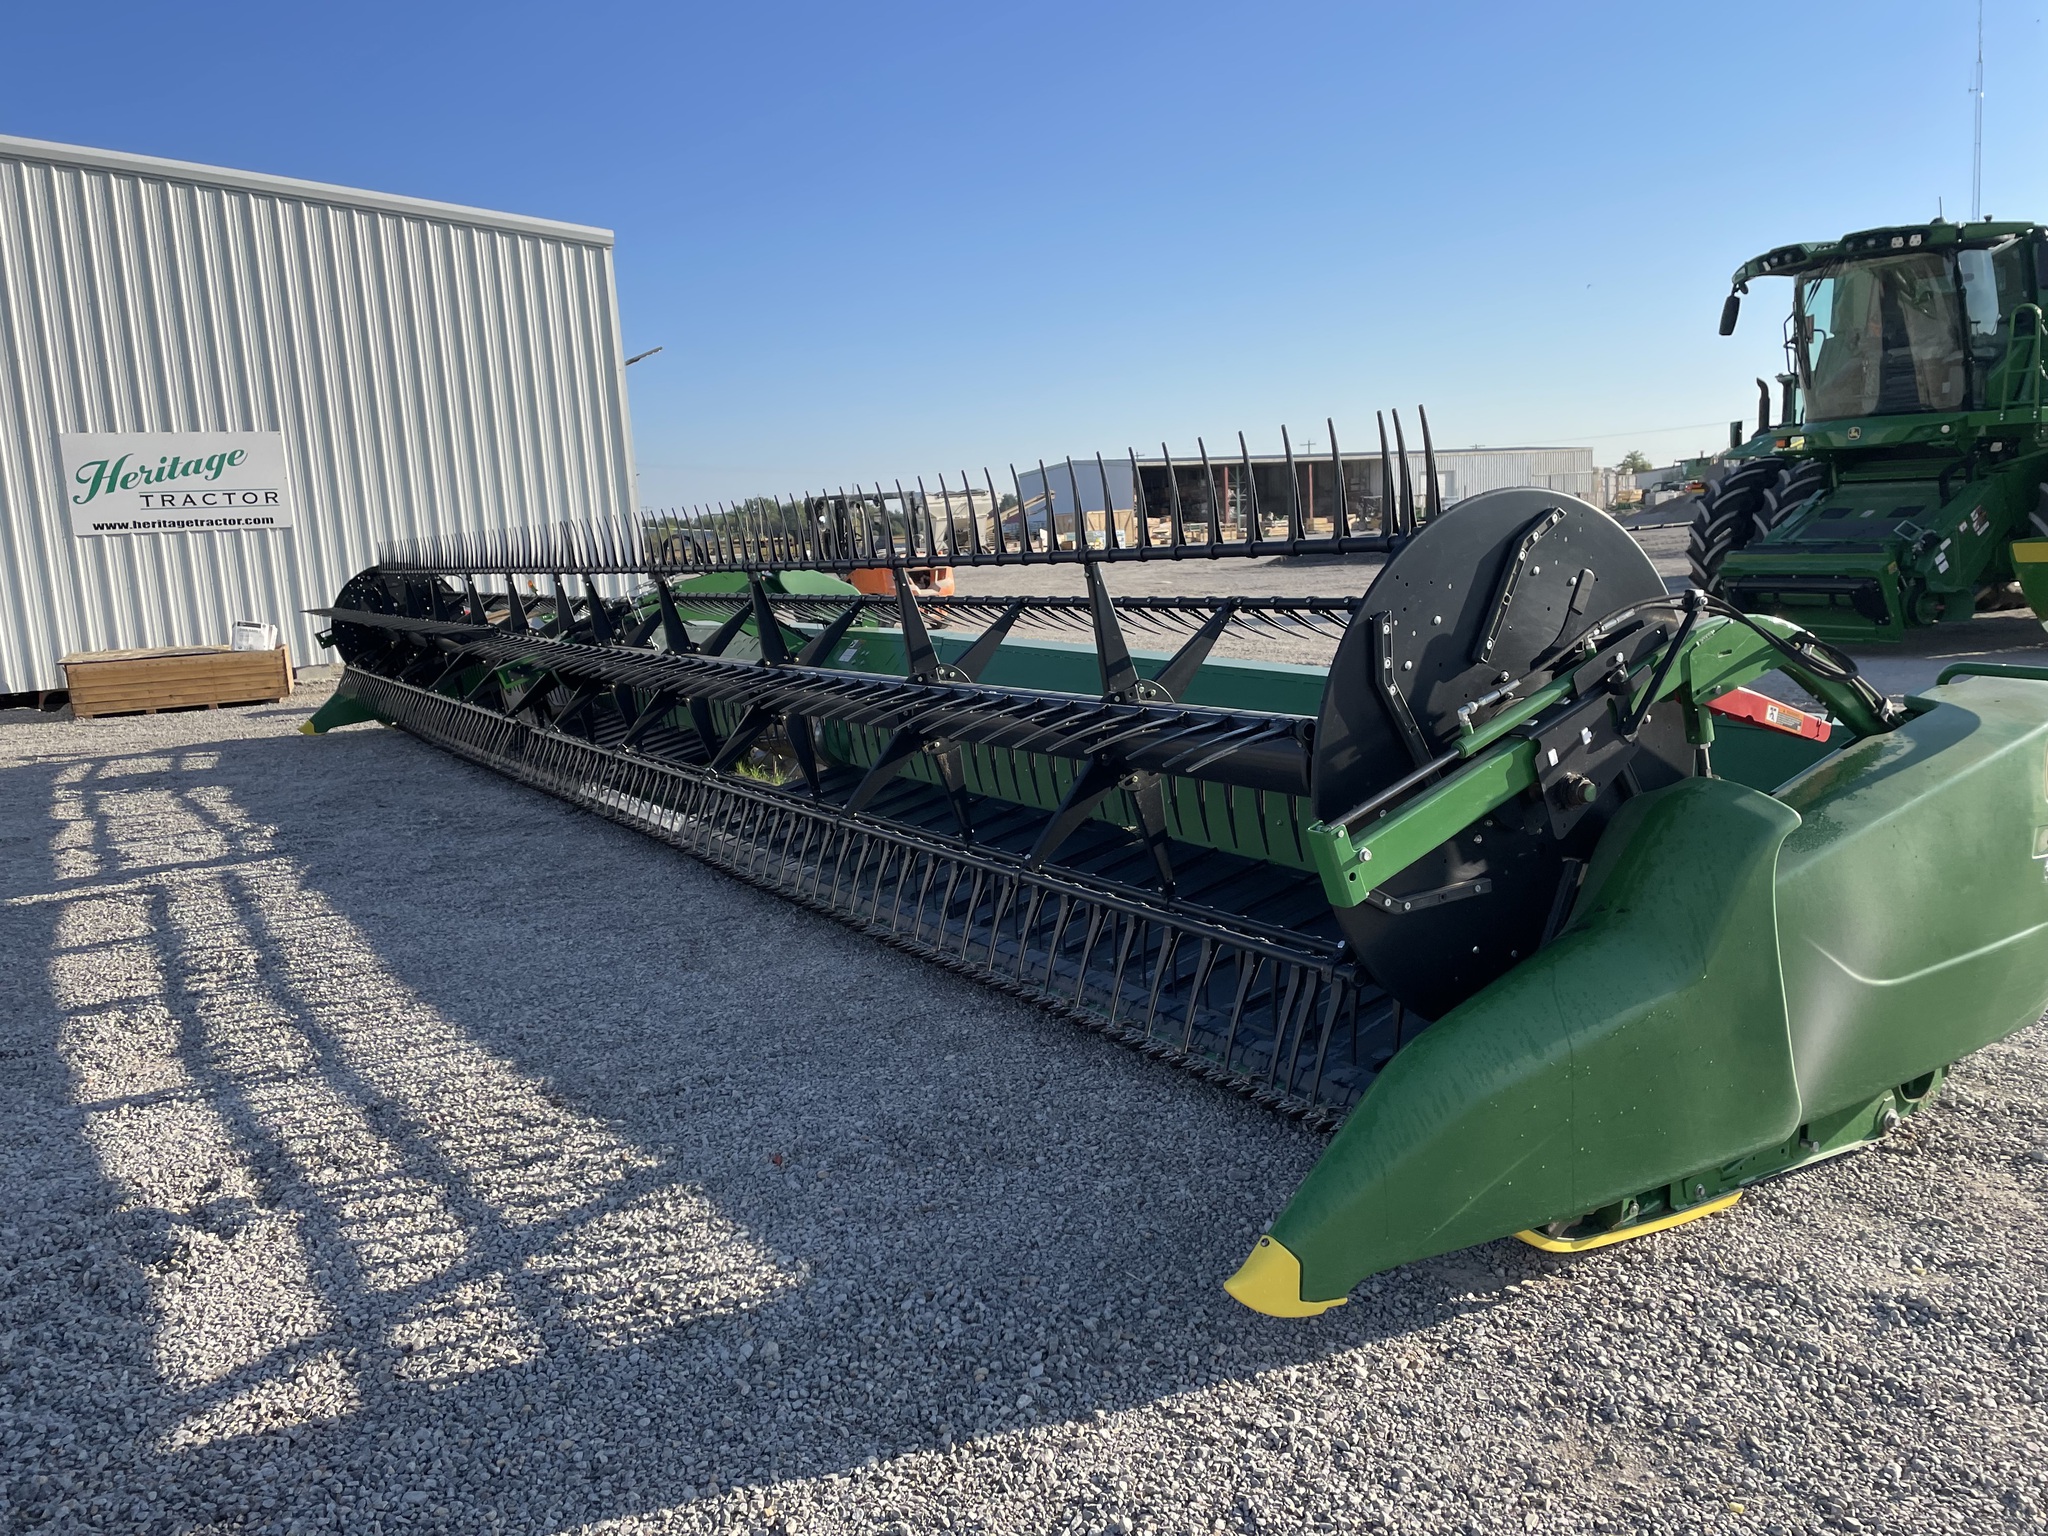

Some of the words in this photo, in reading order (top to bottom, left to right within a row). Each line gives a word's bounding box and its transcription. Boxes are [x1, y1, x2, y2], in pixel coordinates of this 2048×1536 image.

[72, 448, 248, 505] Heritage
[139, 491, 279, 507] TRACTOR
[92, 516, 274, 531] www.heritagetractor.com
